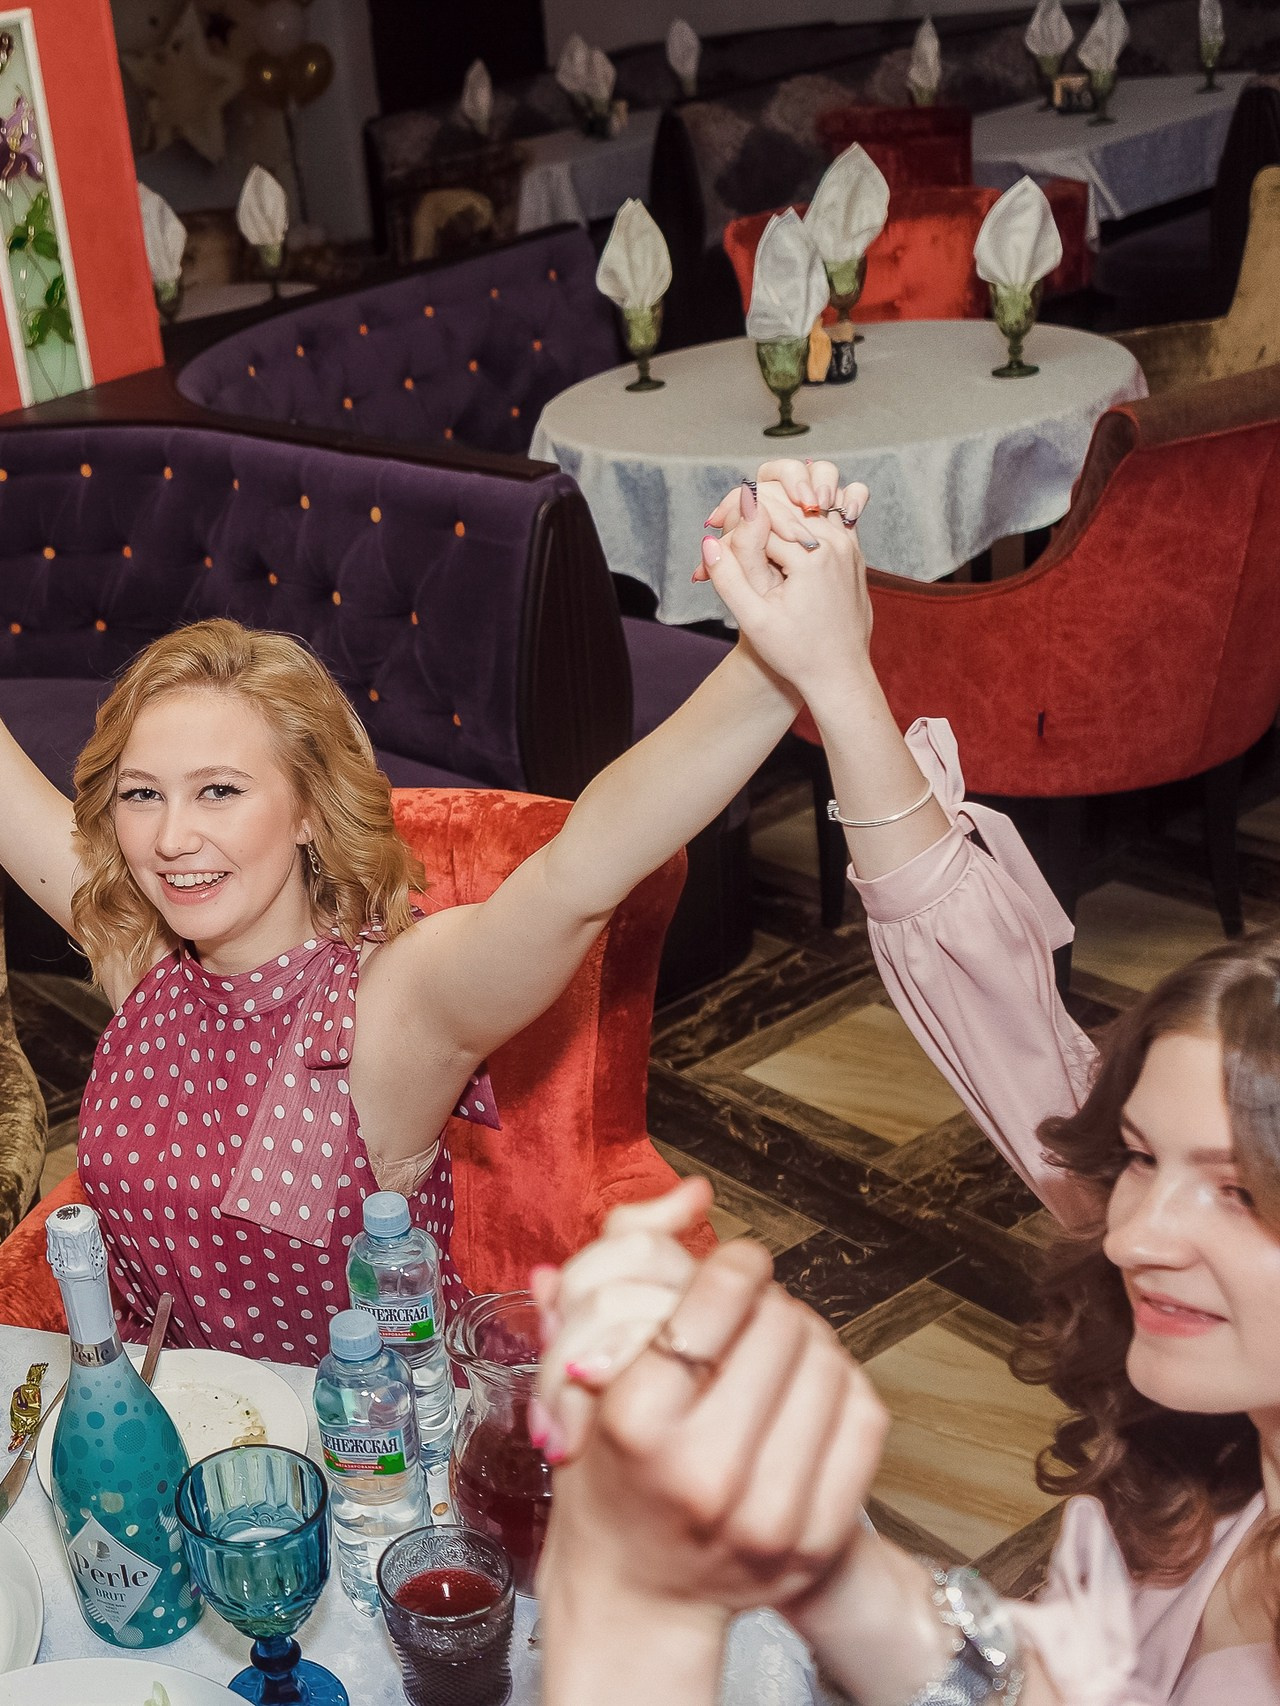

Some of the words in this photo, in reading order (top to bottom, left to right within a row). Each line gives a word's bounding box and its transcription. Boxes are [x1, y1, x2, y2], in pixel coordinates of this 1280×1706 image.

[355, 1304, 429, 1321] НЕЖСКАЯ
[73, 1551, 150, 1588] Perle
[95, 1588, 126, 1602] BRUT
